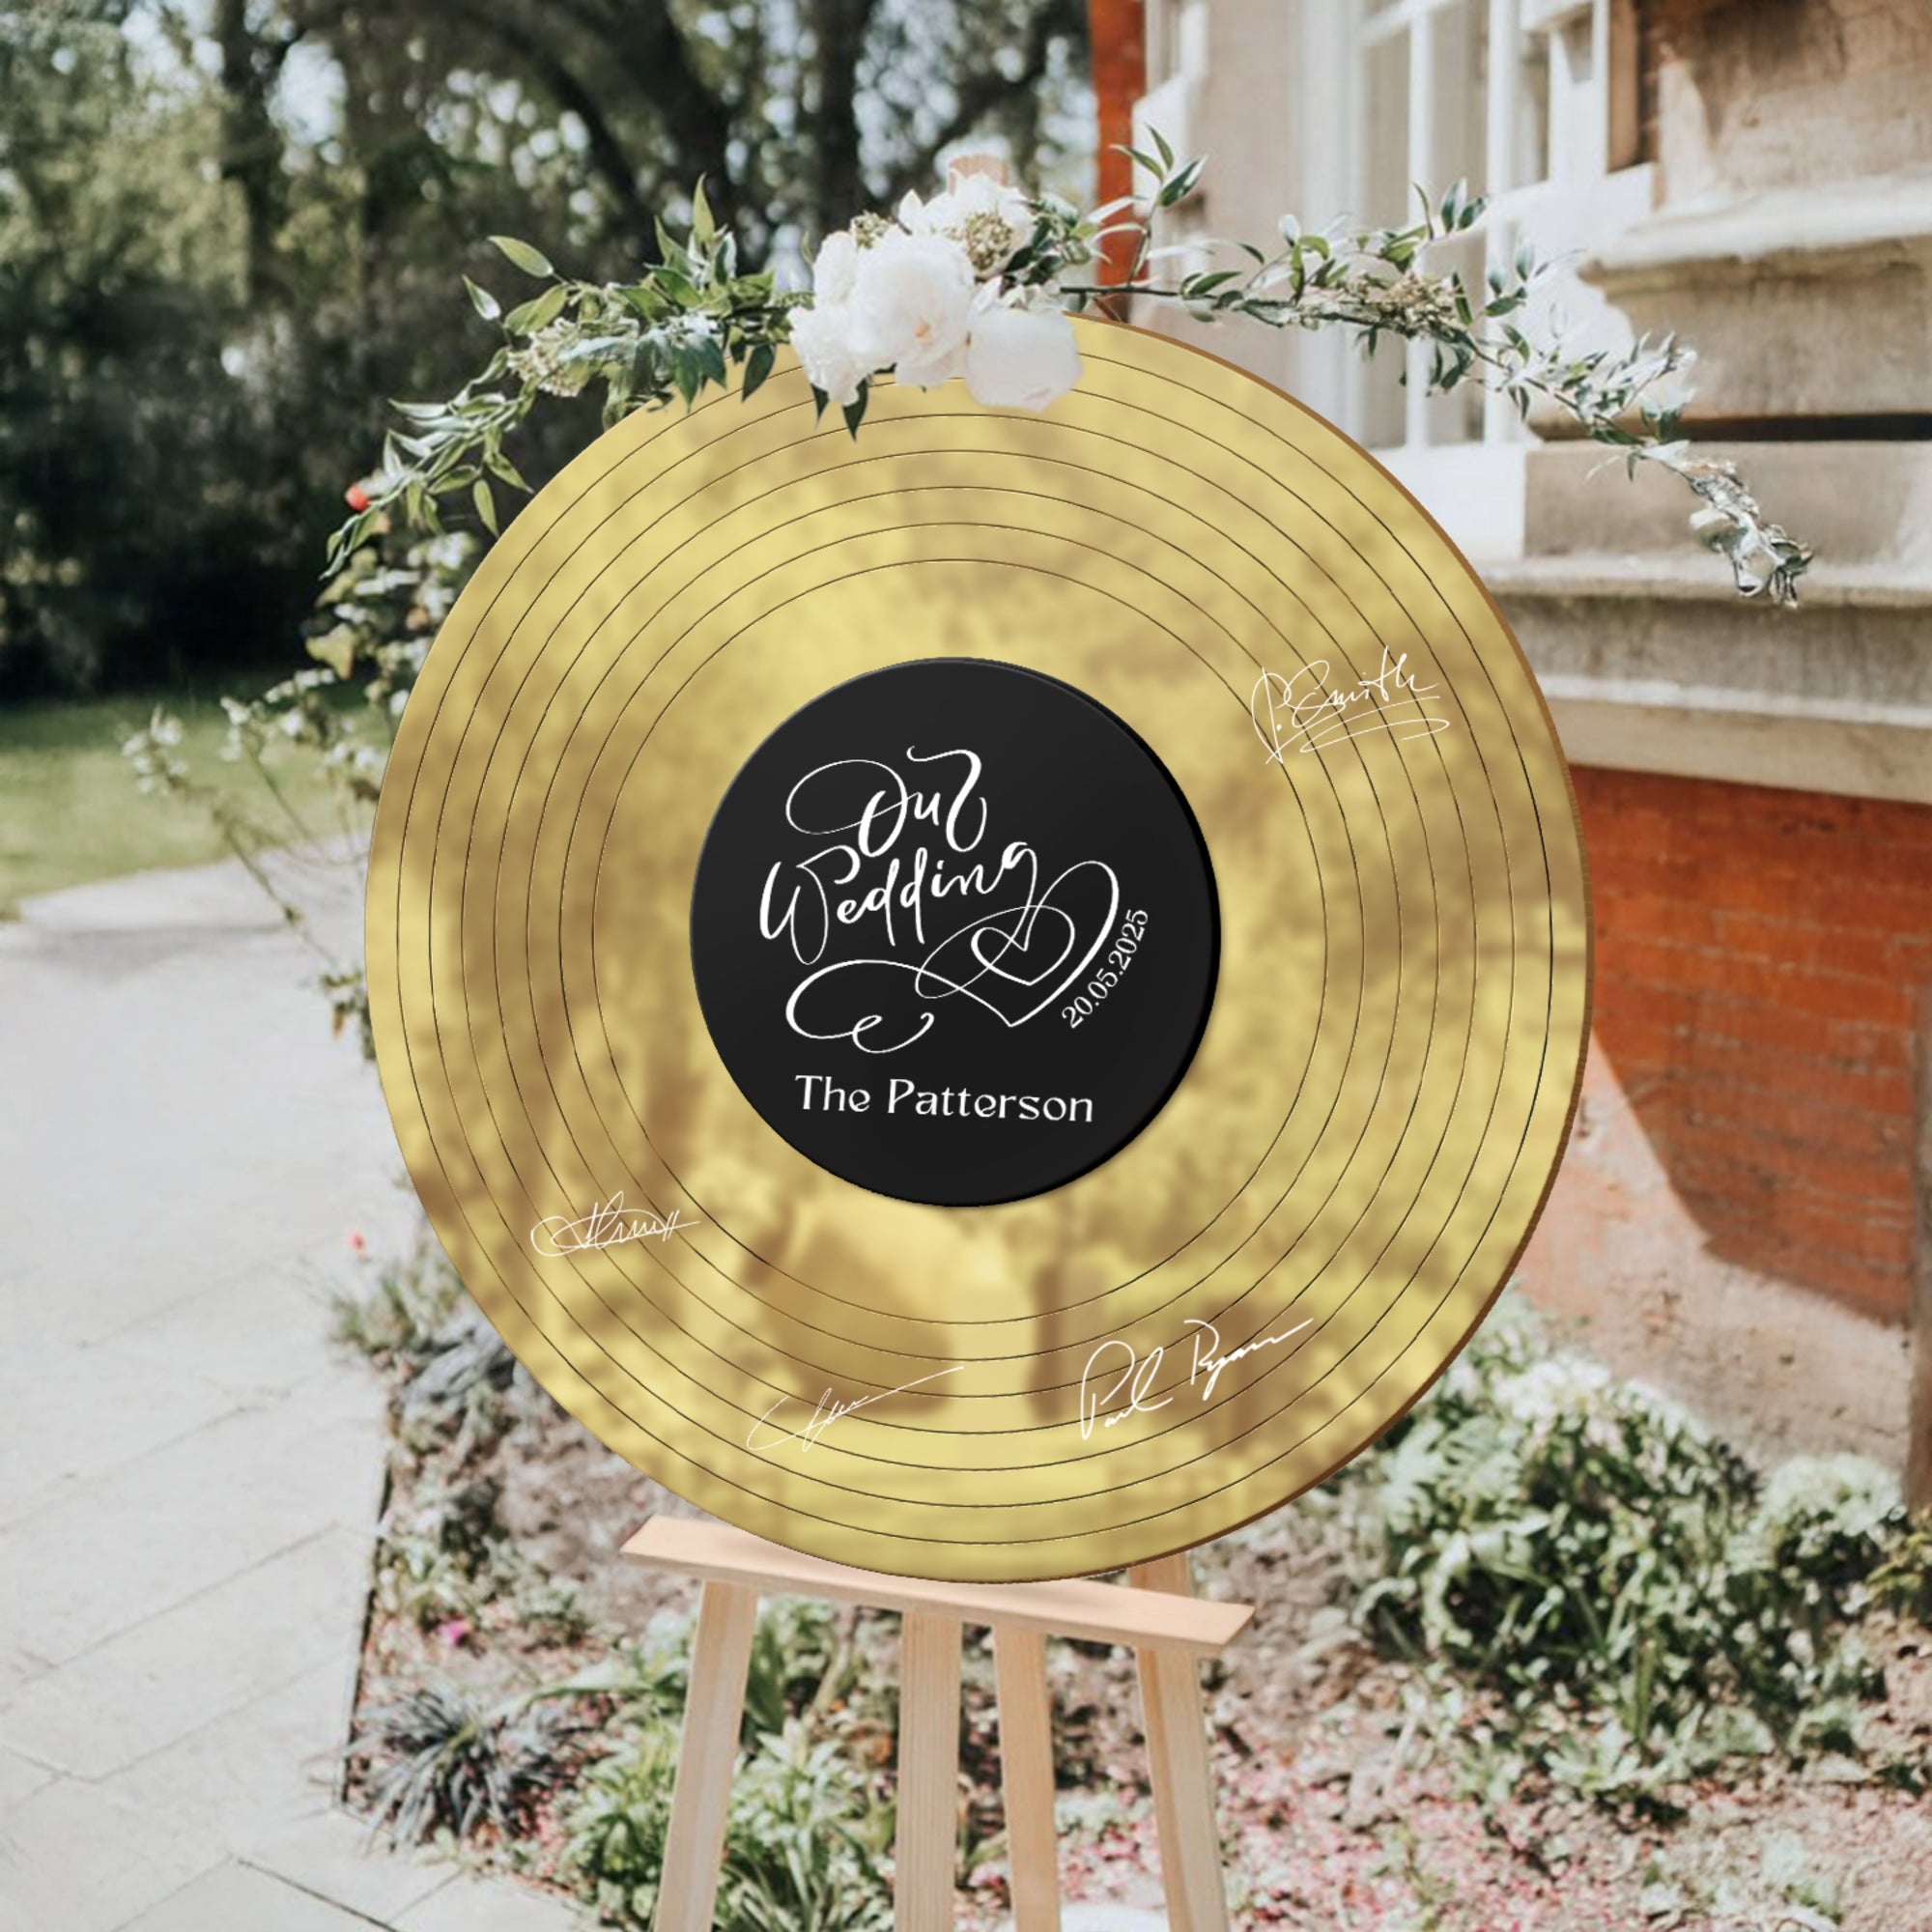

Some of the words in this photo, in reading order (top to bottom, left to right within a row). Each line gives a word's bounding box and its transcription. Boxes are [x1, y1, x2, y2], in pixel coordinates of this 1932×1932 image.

[785, 746, 987, 858] Our
[759, 841, 1038, 965] Wedding
[1062, 909, 1149, 1029] 20.05.2025
[795, 1074, 871, 1113] The
[888, 1078, 1094, 1122] Patterson
